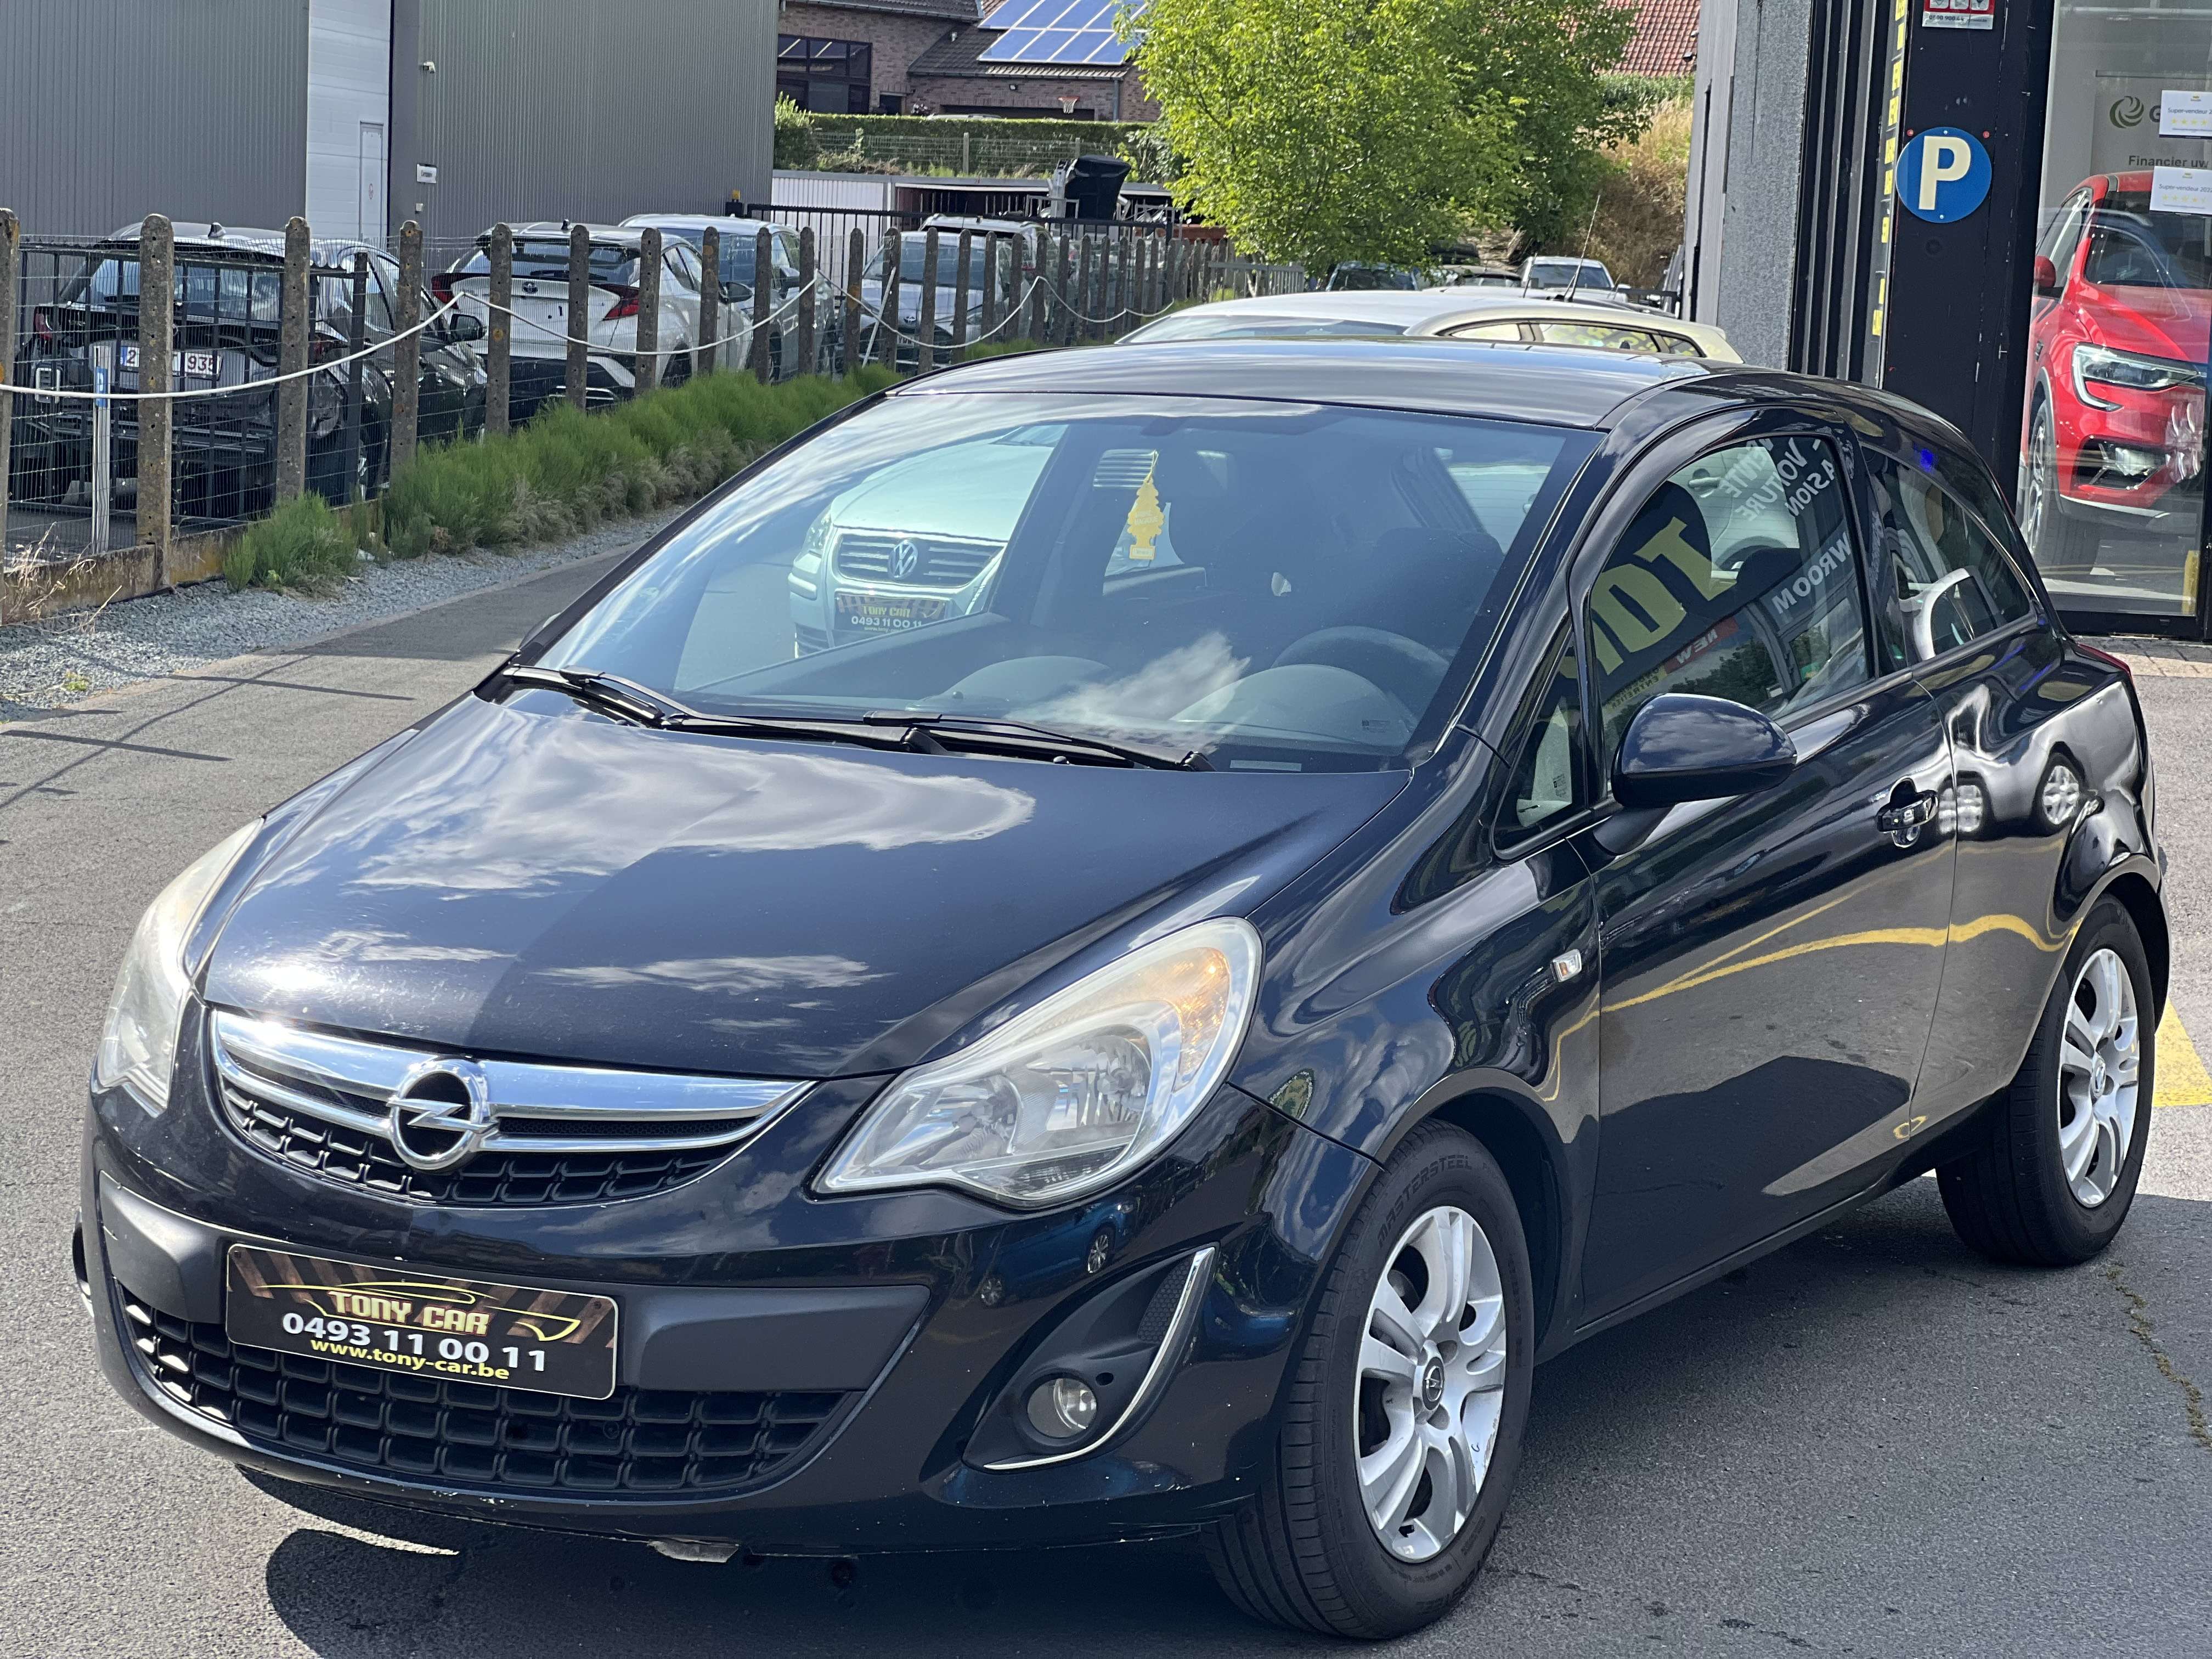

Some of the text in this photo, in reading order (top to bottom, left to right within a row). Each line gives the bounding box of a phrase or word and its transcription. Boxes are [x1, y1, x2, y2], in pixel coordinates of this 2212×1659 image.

[1918, 136, 1971, 210] P
[2129, 155, 2187, 167] Financier
[2159, 183, 2199, 191] Super-vendeur
[851, 616, 879, 625] 0493
[882, 618, 890, 627] 11
[893, 618, 911, 628] 00
[1377, 1155, 1472, 1248] MASTERSTEEL
[328, 1290, 490, 1335] TONY CAR
[283, 1313, 545, 1372] 0493 11 00 11
[310, 1340, 510, 1380] www.tony-car.be
